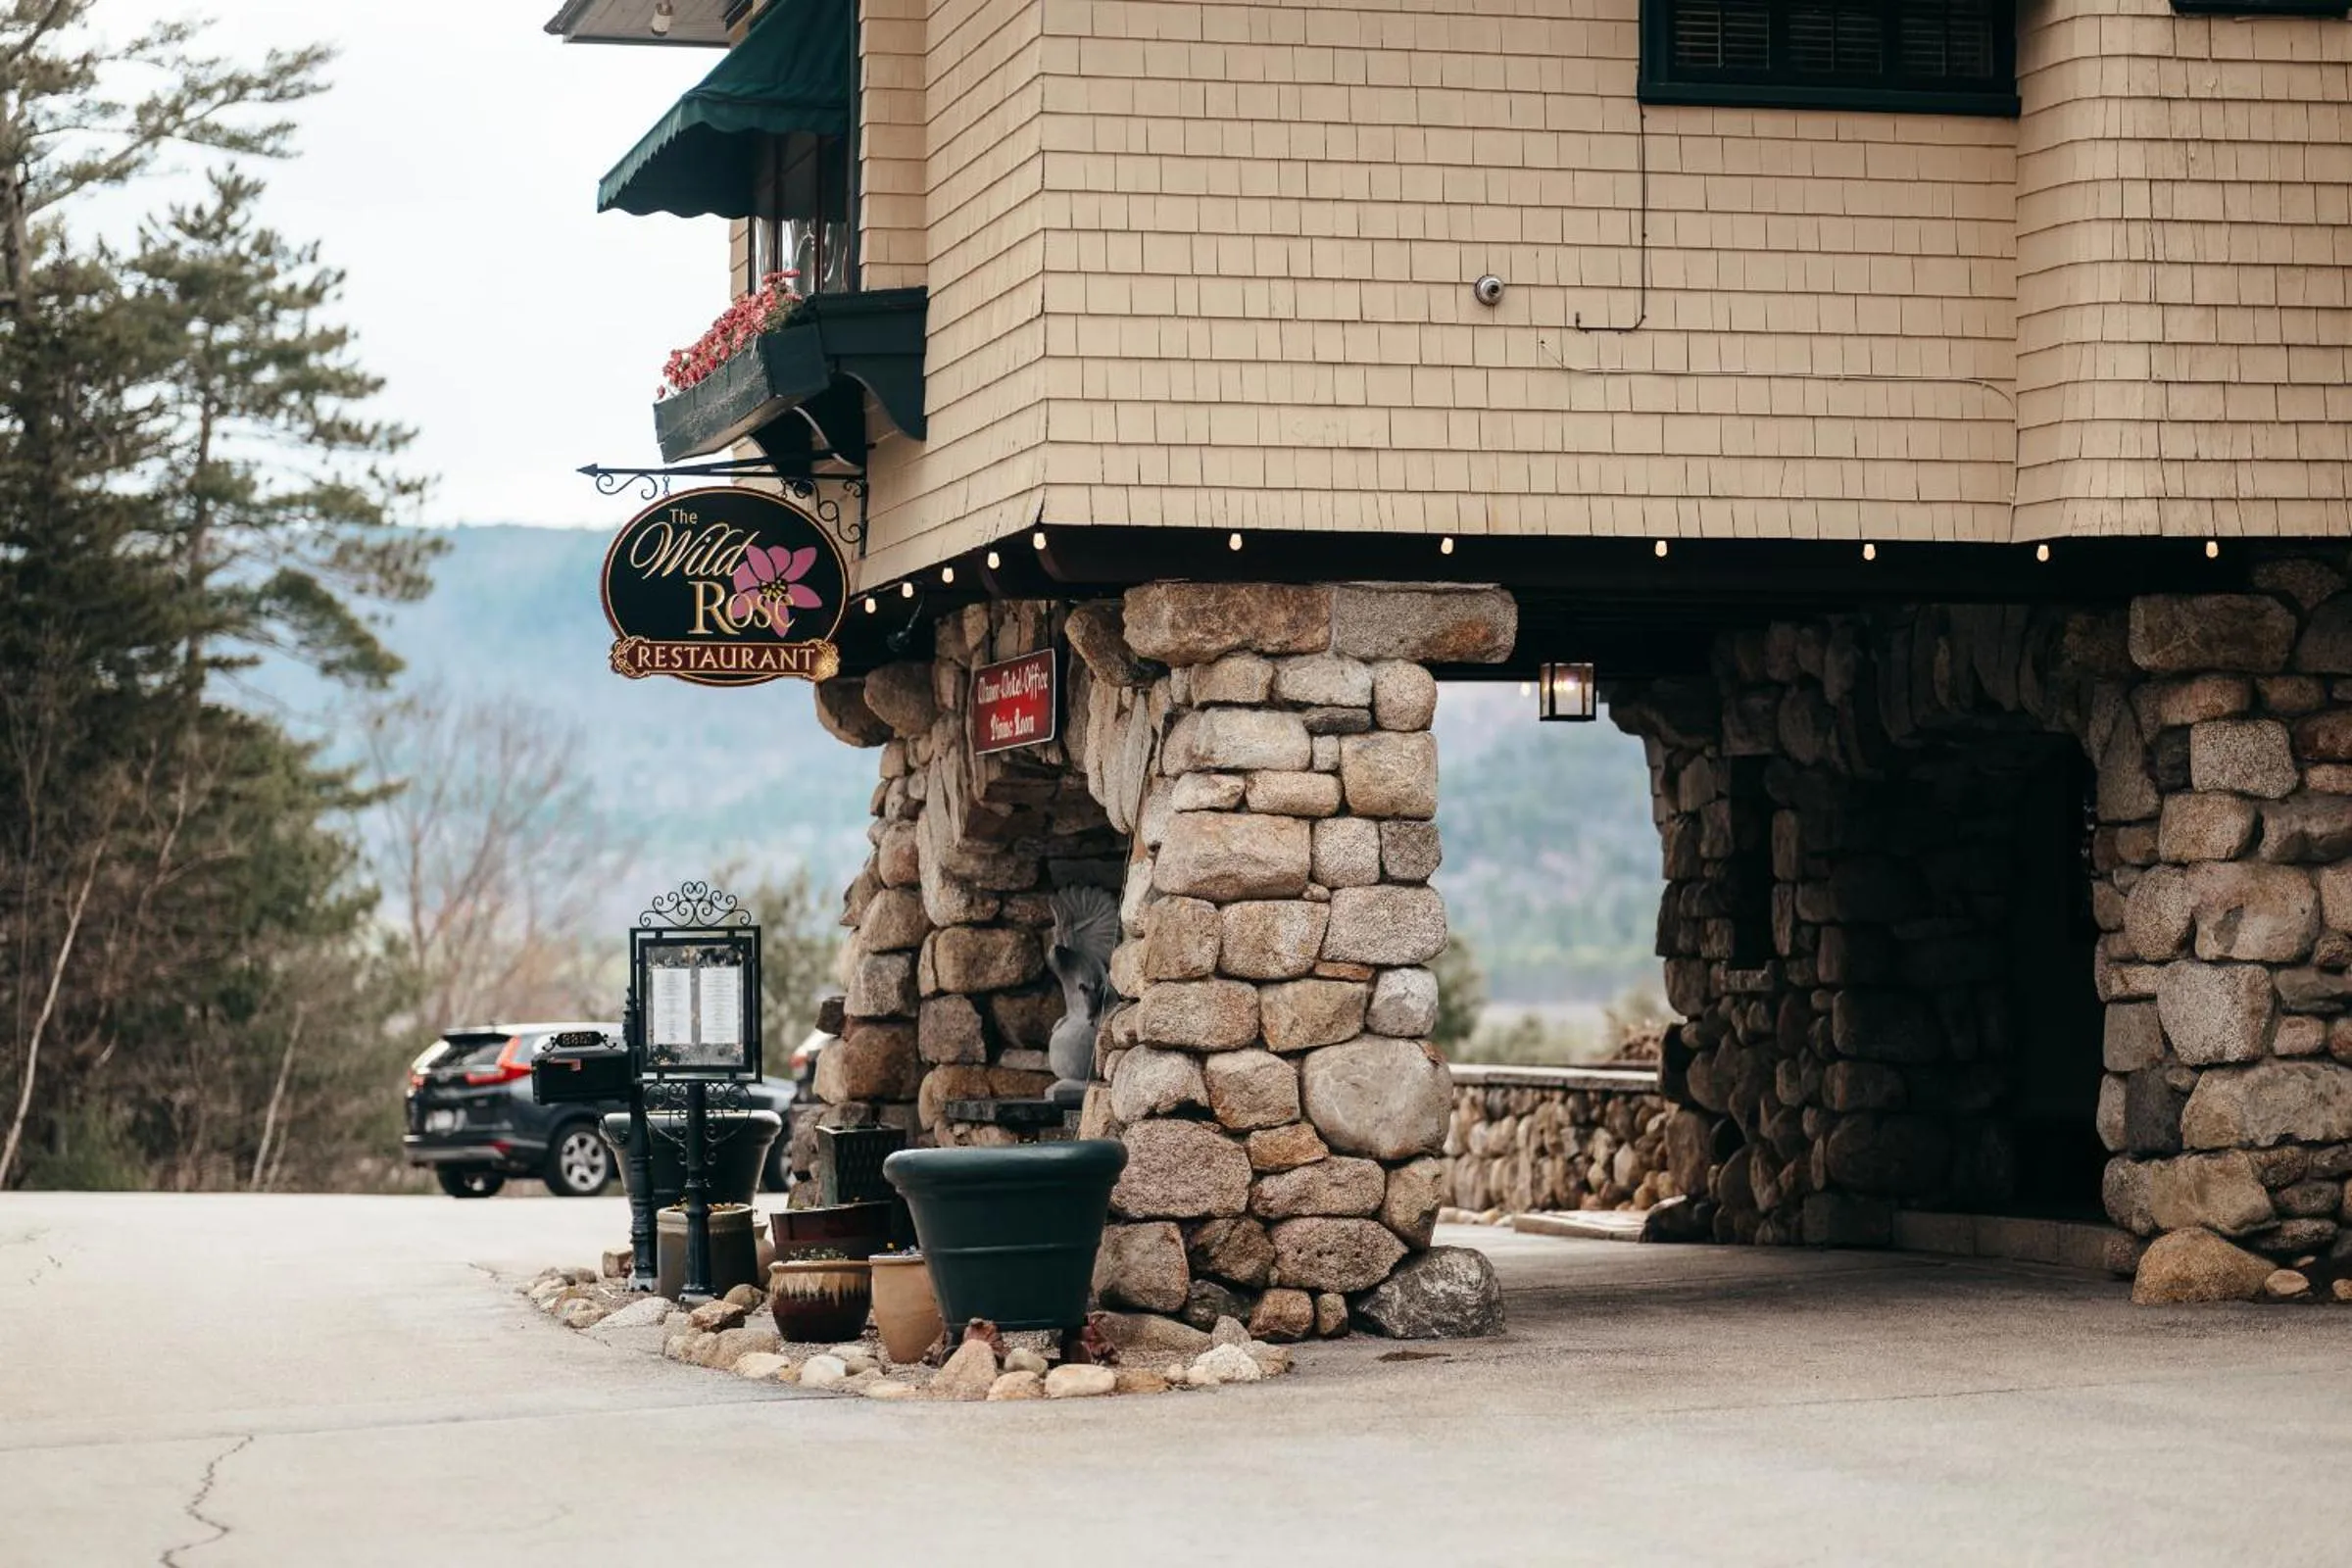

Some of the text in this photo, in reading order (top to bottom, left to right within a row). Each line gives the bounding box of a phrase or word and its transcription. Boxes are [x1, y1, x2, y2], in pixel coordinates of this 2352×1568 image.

[669, 509, 698, 524] The
[629, 521, 760, 580] Wild
[687, 580, 797, 635] Rose
[637, 645, 815, 671] RESTAURANT
